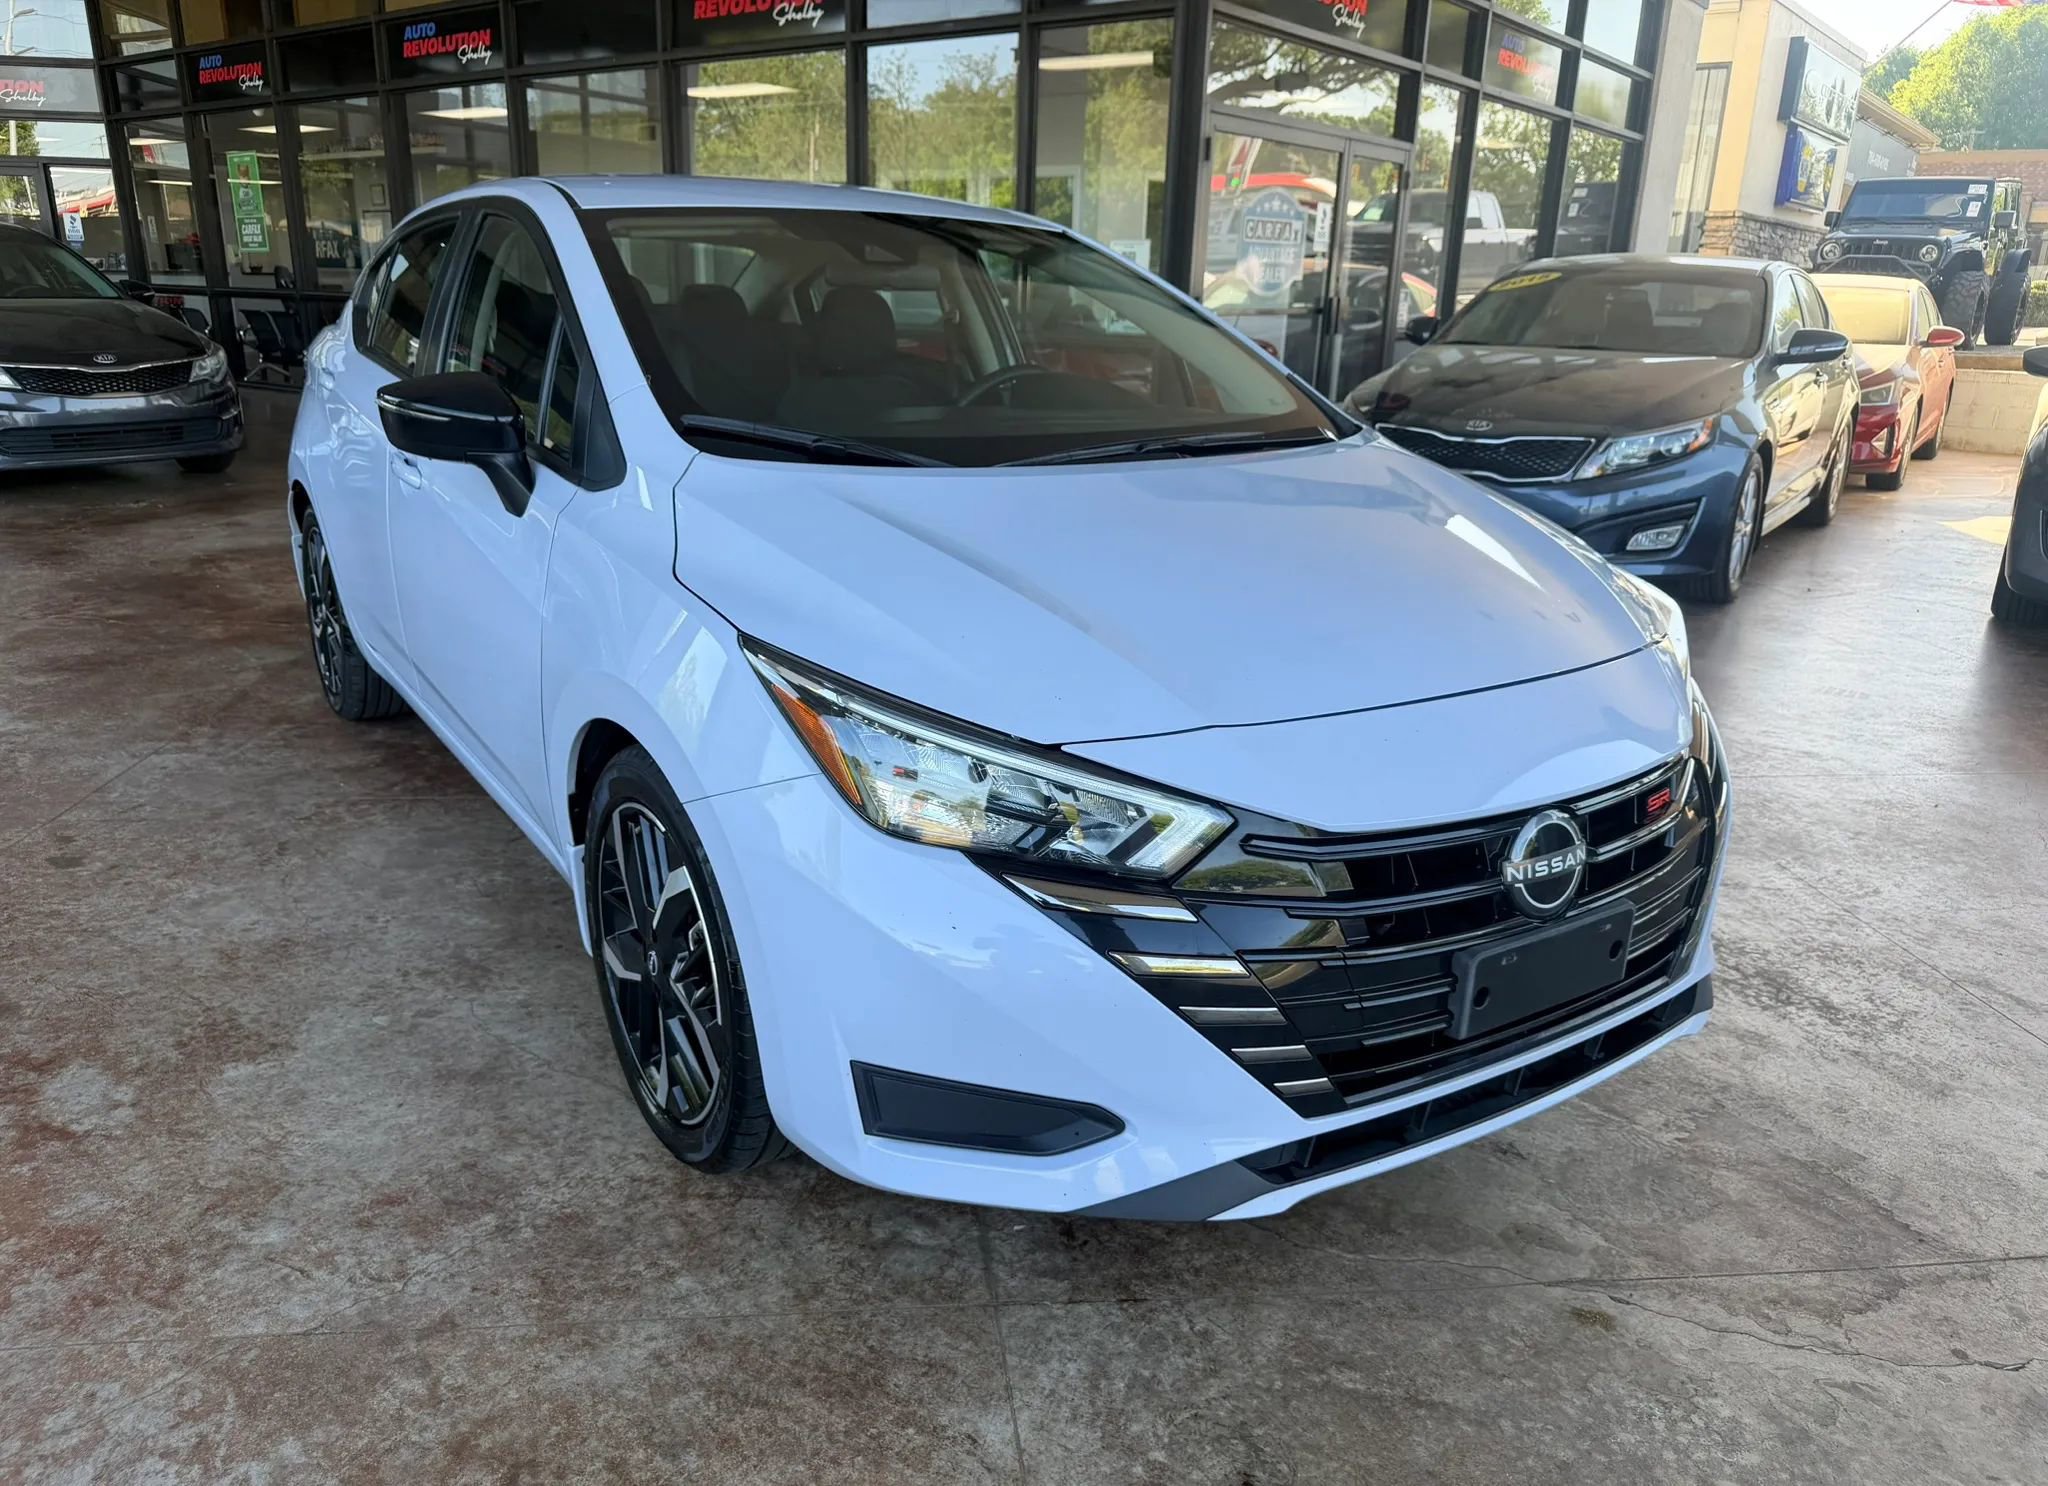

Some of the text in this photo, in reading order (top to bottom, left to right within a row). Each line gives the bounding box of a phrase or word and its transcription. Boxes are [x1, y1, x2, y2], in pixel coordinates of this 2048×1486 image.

[773, 0, 824, 28] Shelby
[1332, 4, 1366, 38] Shelby
[404, 22, 436, 40] AUTO
[403, 29, 491, 58] REVOLUTION
[457, 41, 492, 65] Shelby
[200, 55, 222, 69] AUTO
[200, 62, 262, 84] REVOLUTION
[239, 72, 263, 92] Shelby
[0, 88, 46, 107] Shelby
[1647, 787, 1671, 812] SR
[1507, 848, 1586, 881] NISSAN
